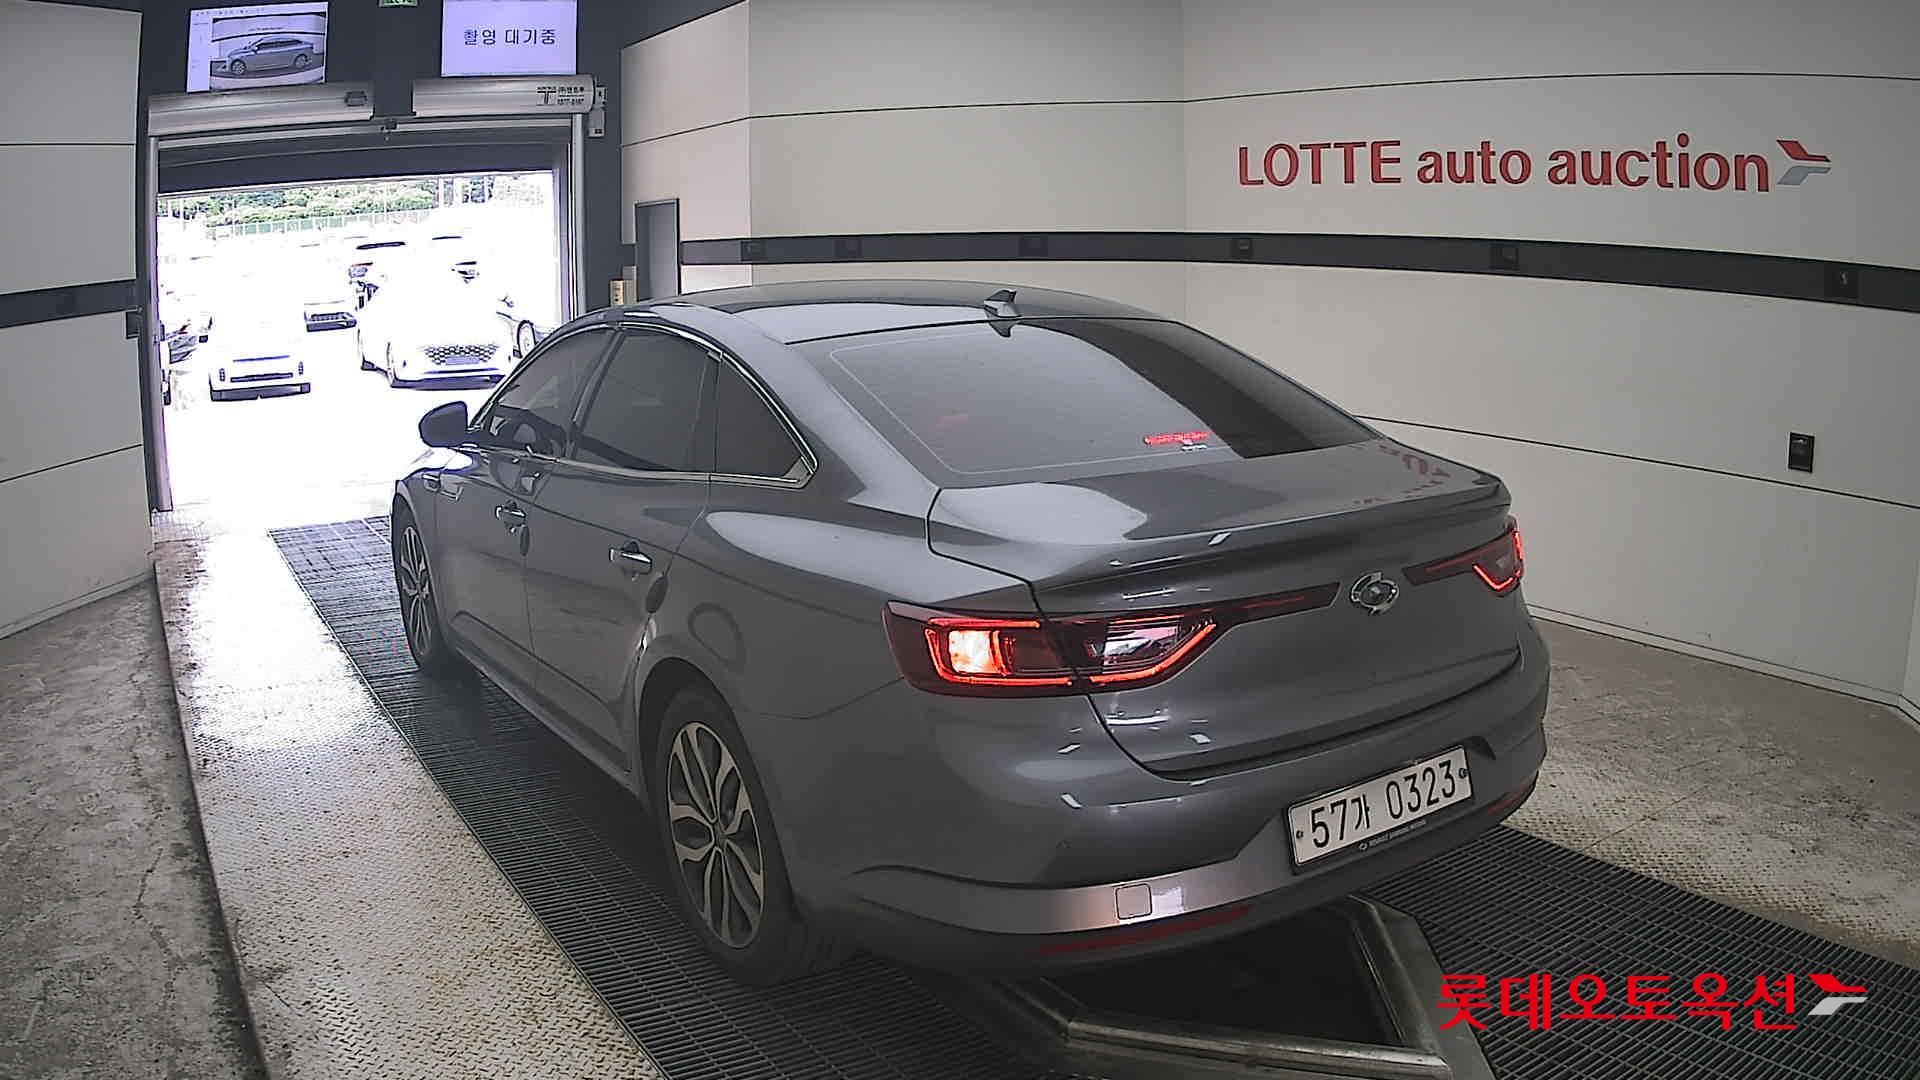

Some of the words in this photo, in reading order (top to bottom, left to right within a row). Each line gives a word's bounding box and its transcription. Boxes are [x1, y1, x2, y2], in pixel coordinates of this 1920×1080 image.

[505, 29, 556, 45] 대기중
[1239, 140, 1401, 187] LOTTE
[1417, 141, 1532, 185] auto
[1548, 133, 1769, 193] auction
[1311, 793, 1370, 848] 57가
[1386, 759, 1456, 820] 0323
